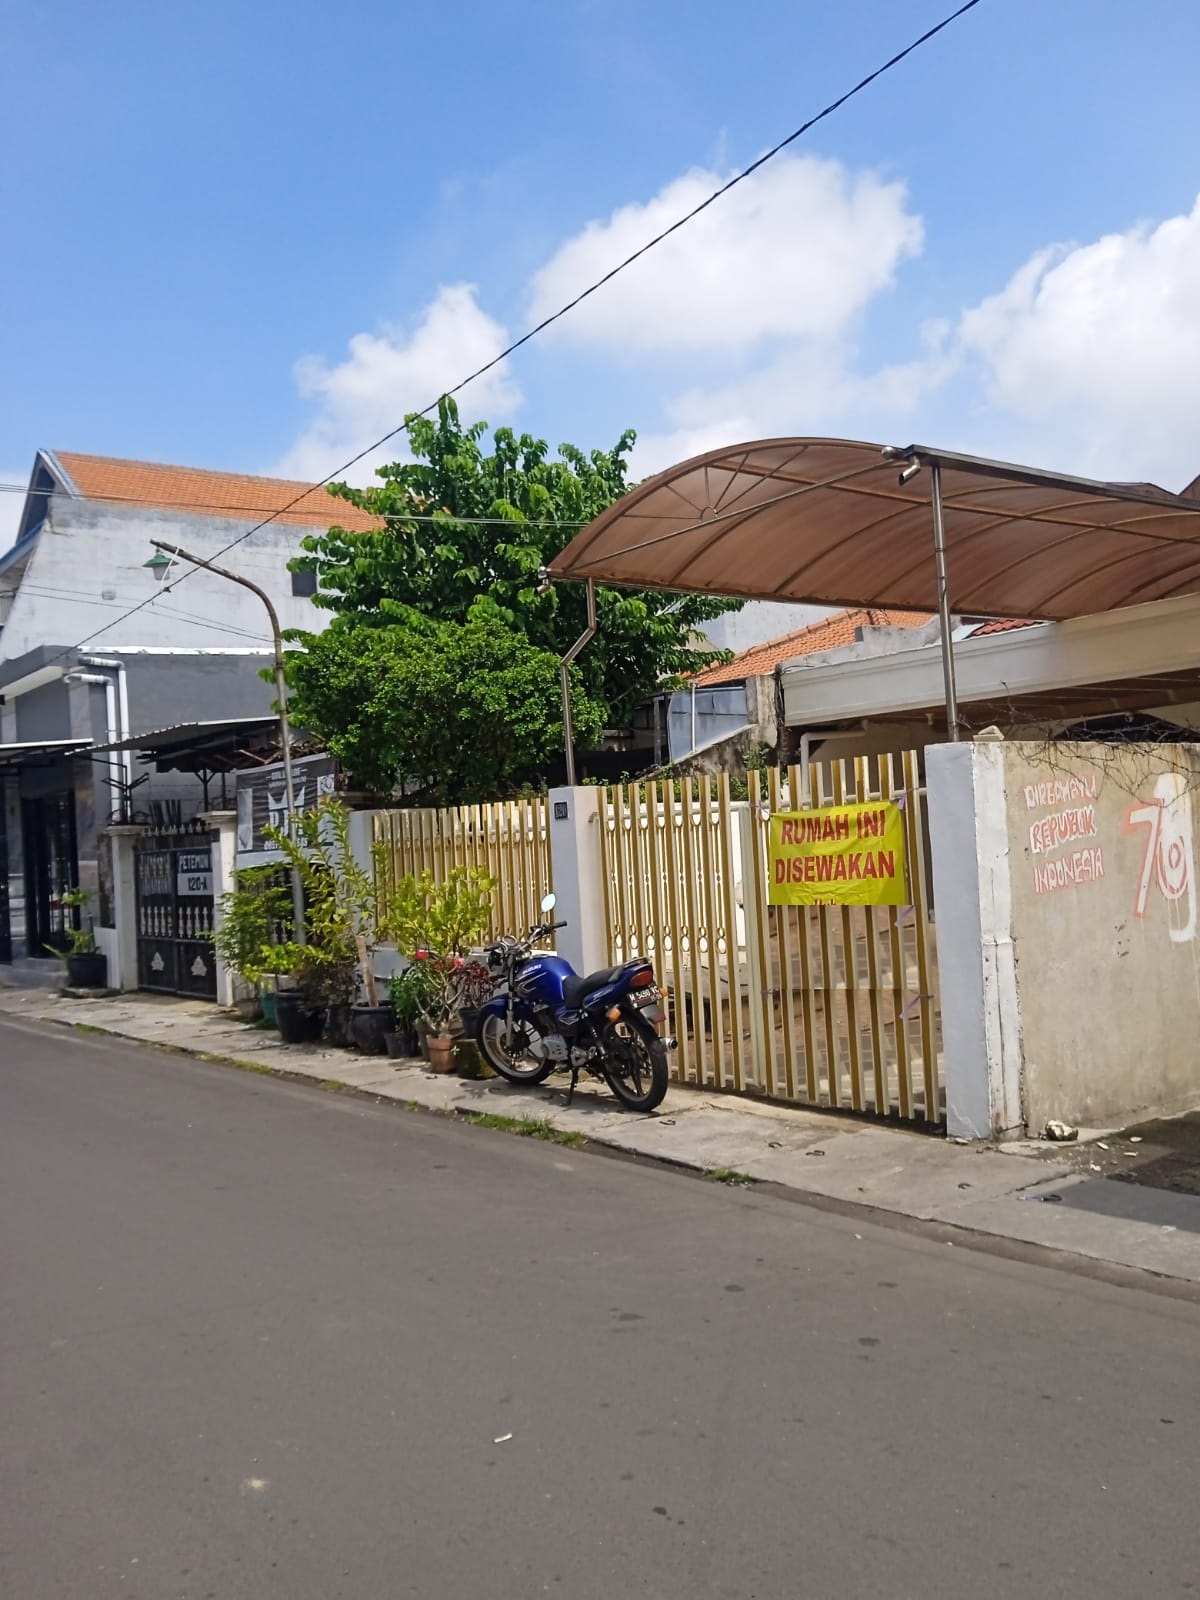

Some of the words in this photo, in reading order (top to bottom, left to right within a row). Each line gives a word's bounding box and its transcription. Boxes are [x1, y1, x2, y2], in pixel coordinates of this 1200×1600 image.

[781, 814, 849, 845] RUMAH
[857, 809, 886, 840] INI
[1030, 805, 1097, 853] REPUBLIK
[775, 850, 895, 884] DISEWAKAN
[1033, 847, 1105, 895] INDONESIA
